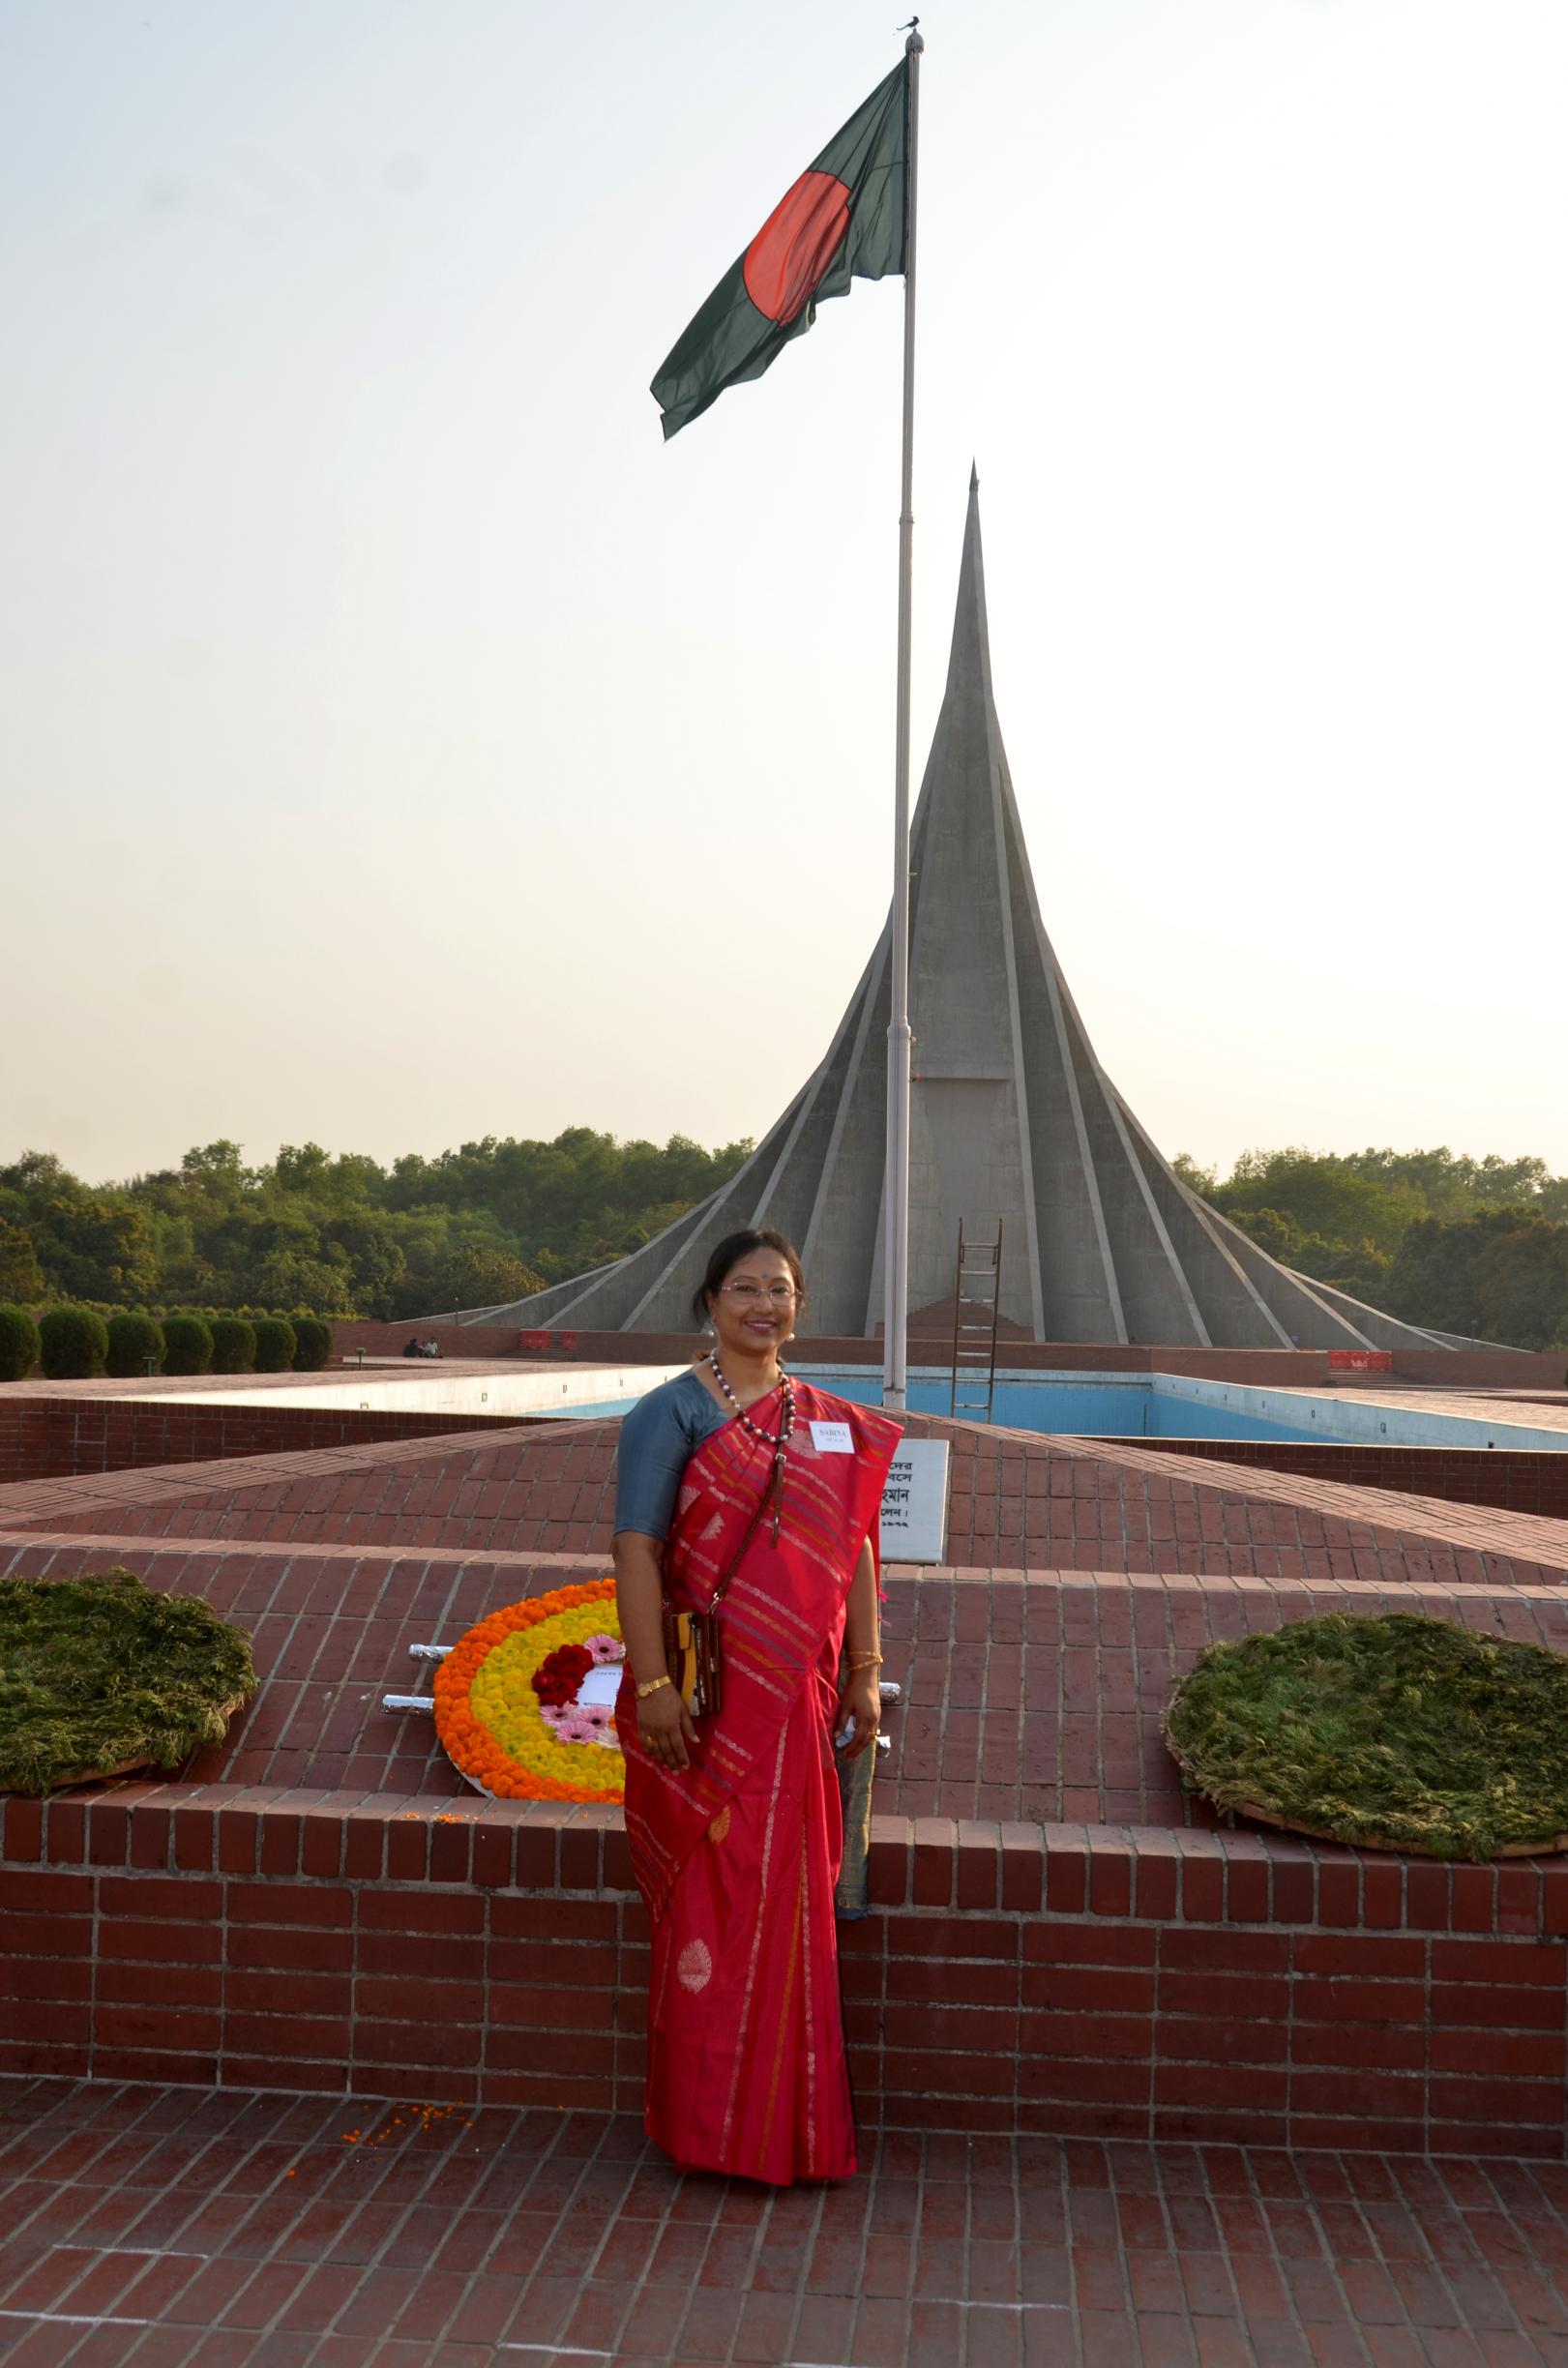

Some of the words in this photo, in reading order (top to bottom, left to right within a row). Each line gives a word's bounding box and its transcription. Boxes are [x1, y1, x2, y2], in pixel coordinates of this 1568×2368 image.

[889, 1462, 913, 1470] দের
[887, 1473, 913, 1482] বসে
[882, 1488, 910, 1503] হমান
[881, 1508, 902, 1517] লেন
